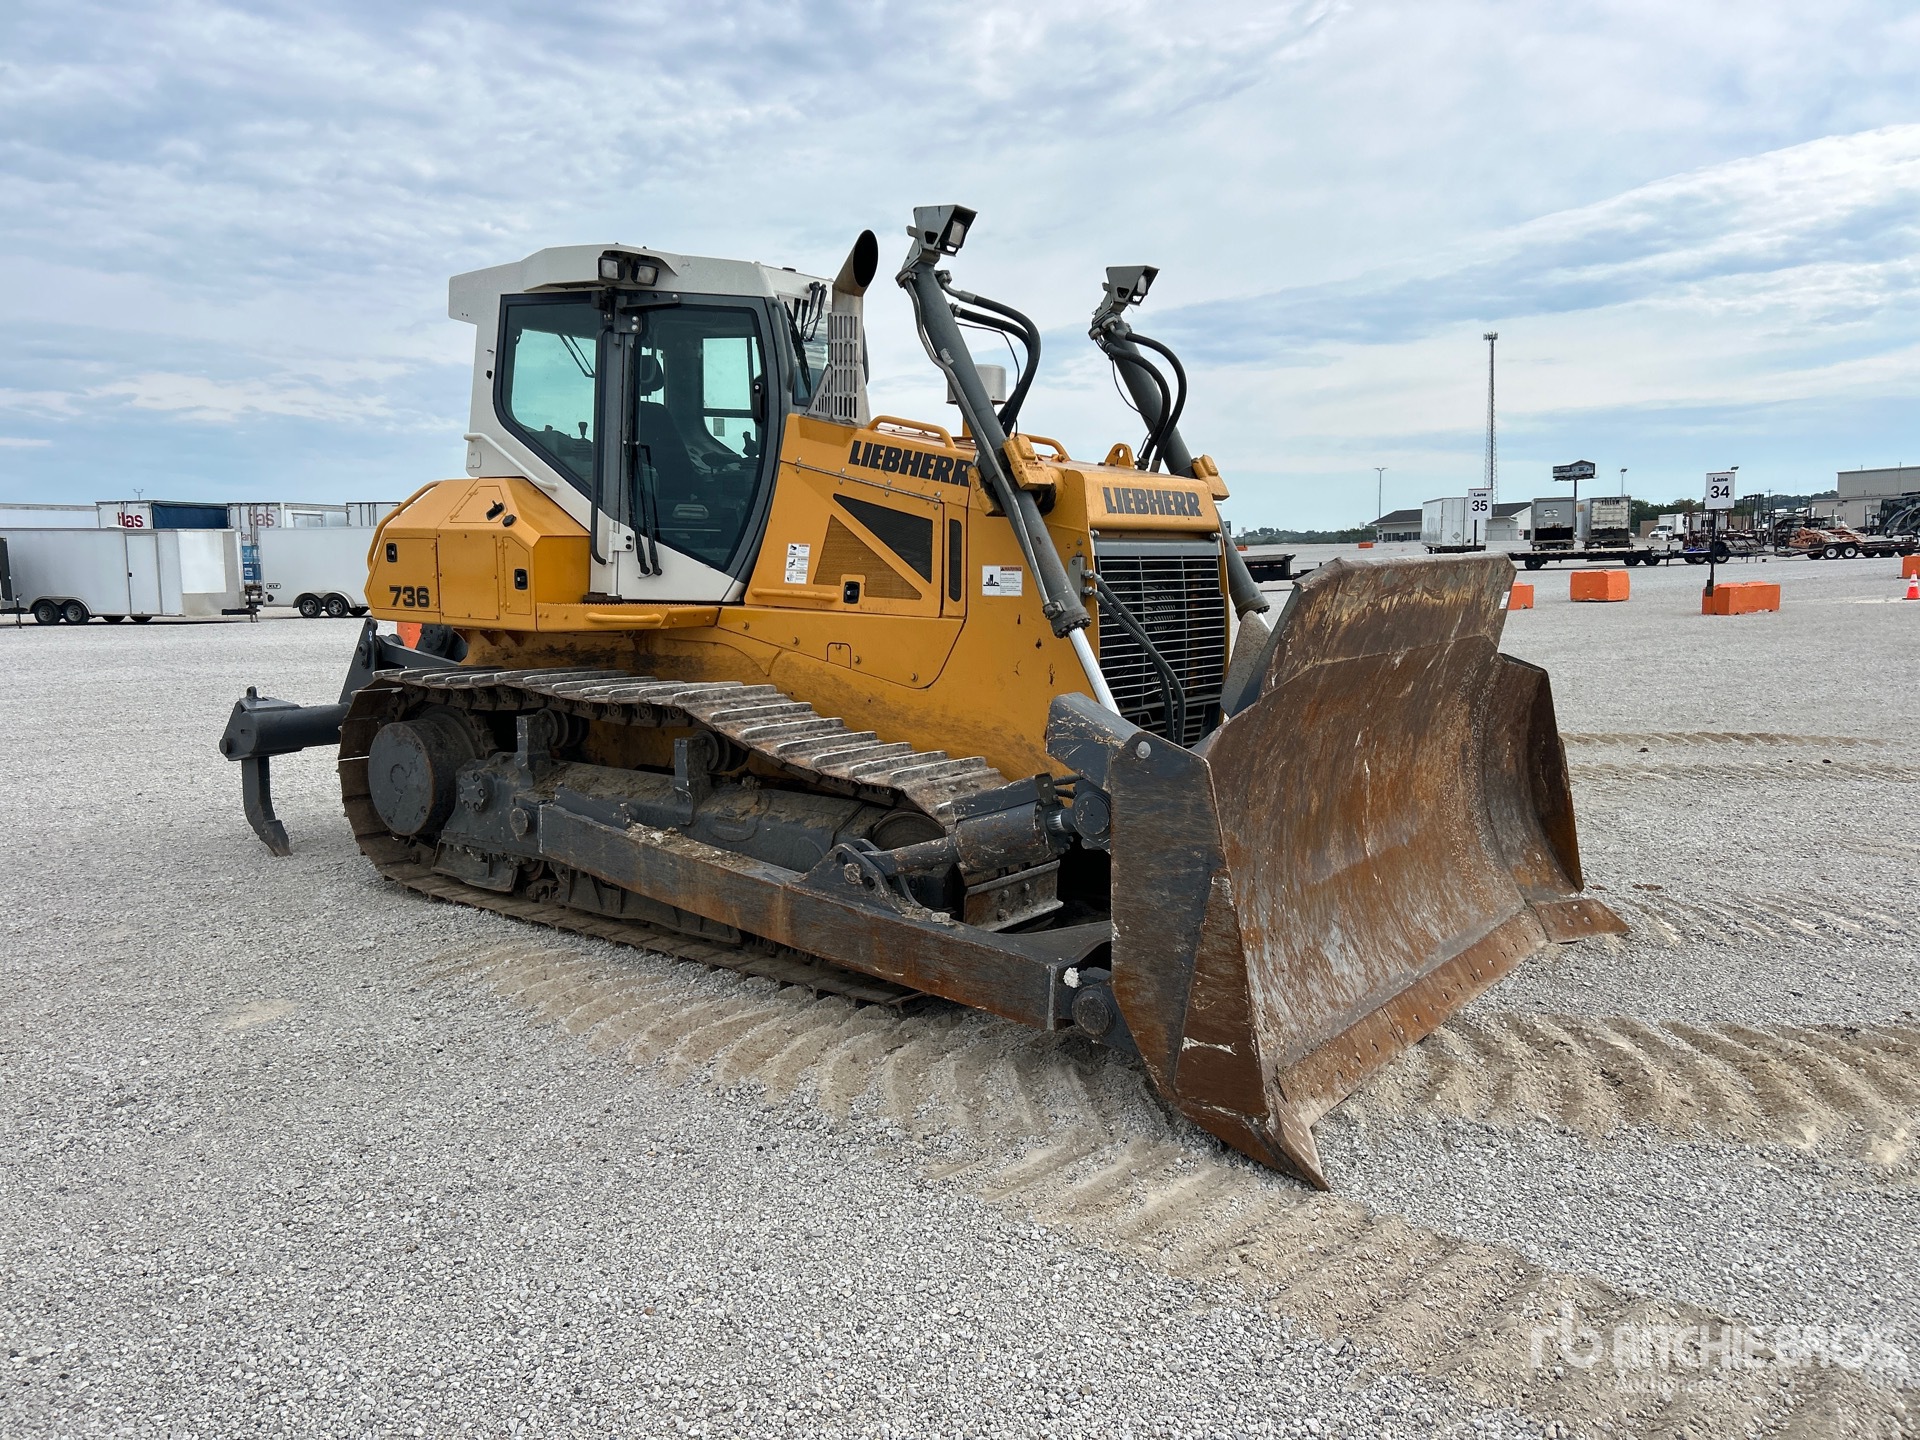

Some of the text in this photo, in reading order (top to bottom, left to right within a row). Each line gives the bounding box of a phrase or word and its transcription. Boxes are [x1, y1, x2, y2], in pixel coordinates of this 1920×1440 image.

[848, 440, 974, 487] LIEBHERR
[1102, 487, 1203, 517] LIEBHERR
[1710, 485, 1730, 499] 34
[1471, 500, 1488, 512] 35
[389, 585, 430, 609] 736
